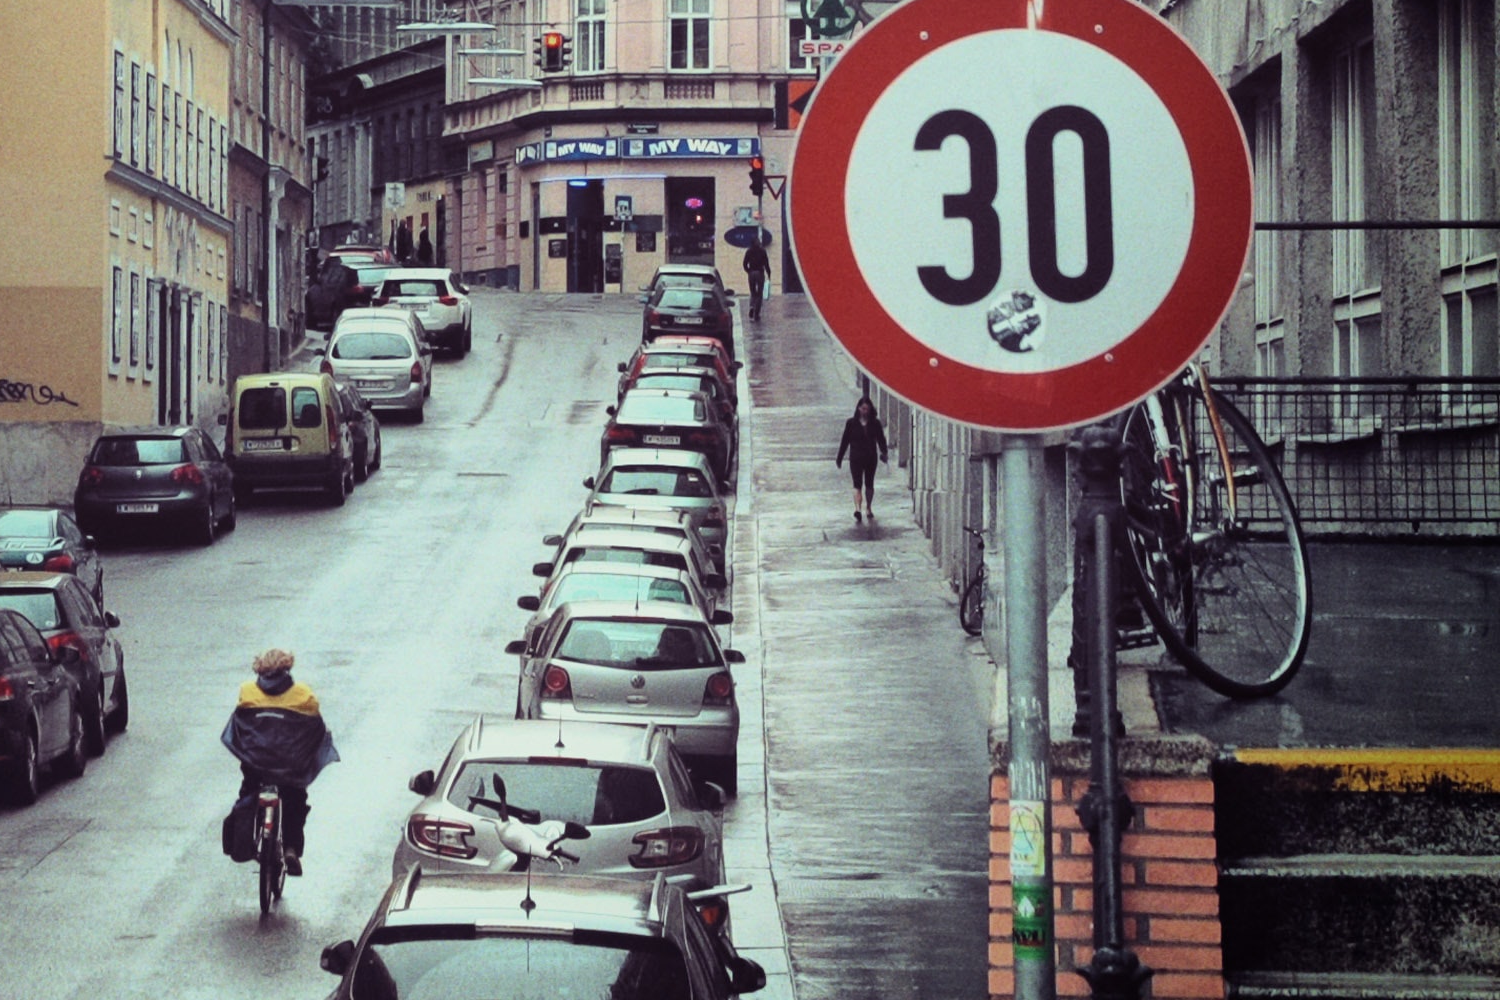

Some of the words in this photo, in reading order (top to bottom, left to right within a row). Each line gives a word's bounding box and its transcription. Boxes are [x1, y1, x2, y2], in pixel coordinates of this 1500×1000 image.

[802, 43, 844, 54] SPA
[558, 142, 576, 157] MY
[579, 141, 604, 156] WAY
[649, 139, 680, 156] MY
[686, 138, 732, 155] WAY
[913, 104, 1114, 306] 30
